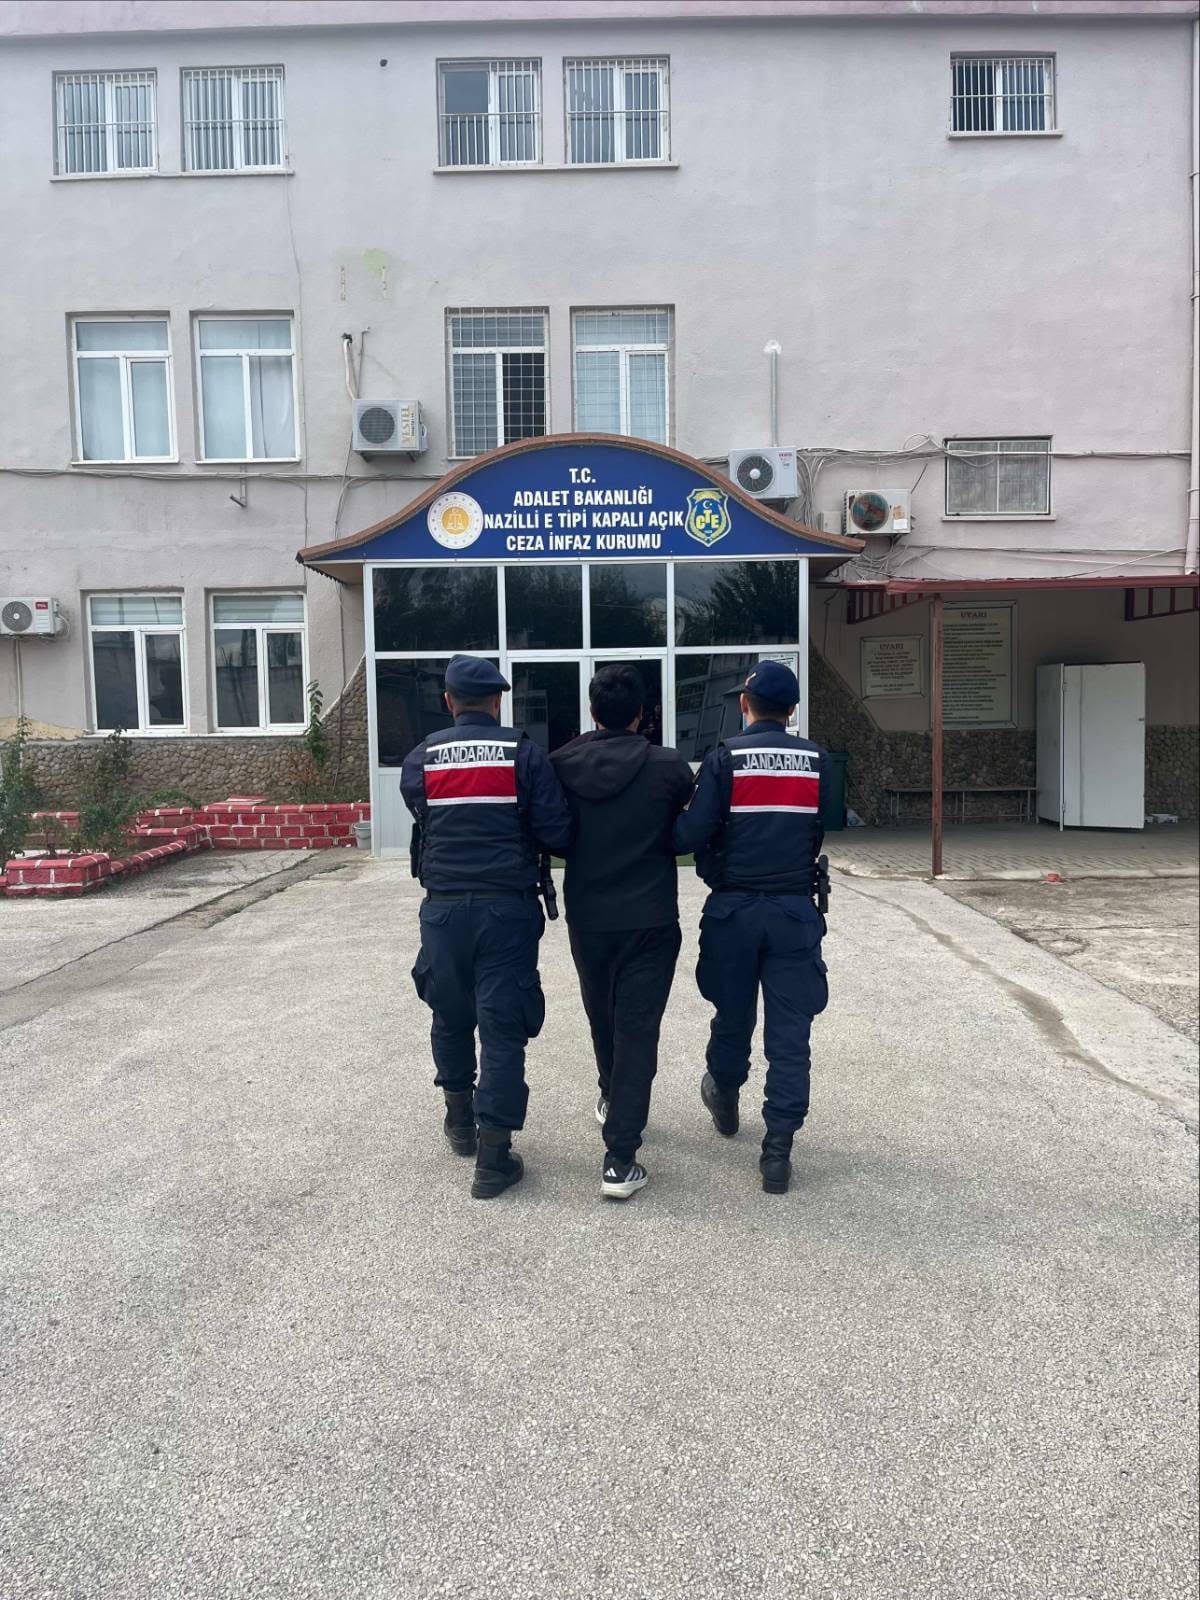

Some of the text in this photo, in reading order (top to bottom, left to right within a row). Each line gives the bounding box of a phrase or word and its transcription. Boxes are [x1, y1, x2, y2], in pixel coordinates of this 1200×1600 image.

[569, 467, 597, 484] T.C.
[513, 486, 653, 507] ADALET BAKANLIĞI
[484, 509, 685, 531] NAZİLLİ E TİPİ KAPALI AÇIK
[506, 531, 662, 551] CEZA İNFAZ KURUMU
[960, 610, 987, 618] UYARI
[879, 642, 904, 650] UYARI
[435, 747, 505, 763] JANDARMA
[742, 753, 812, 772] JANDARMA
